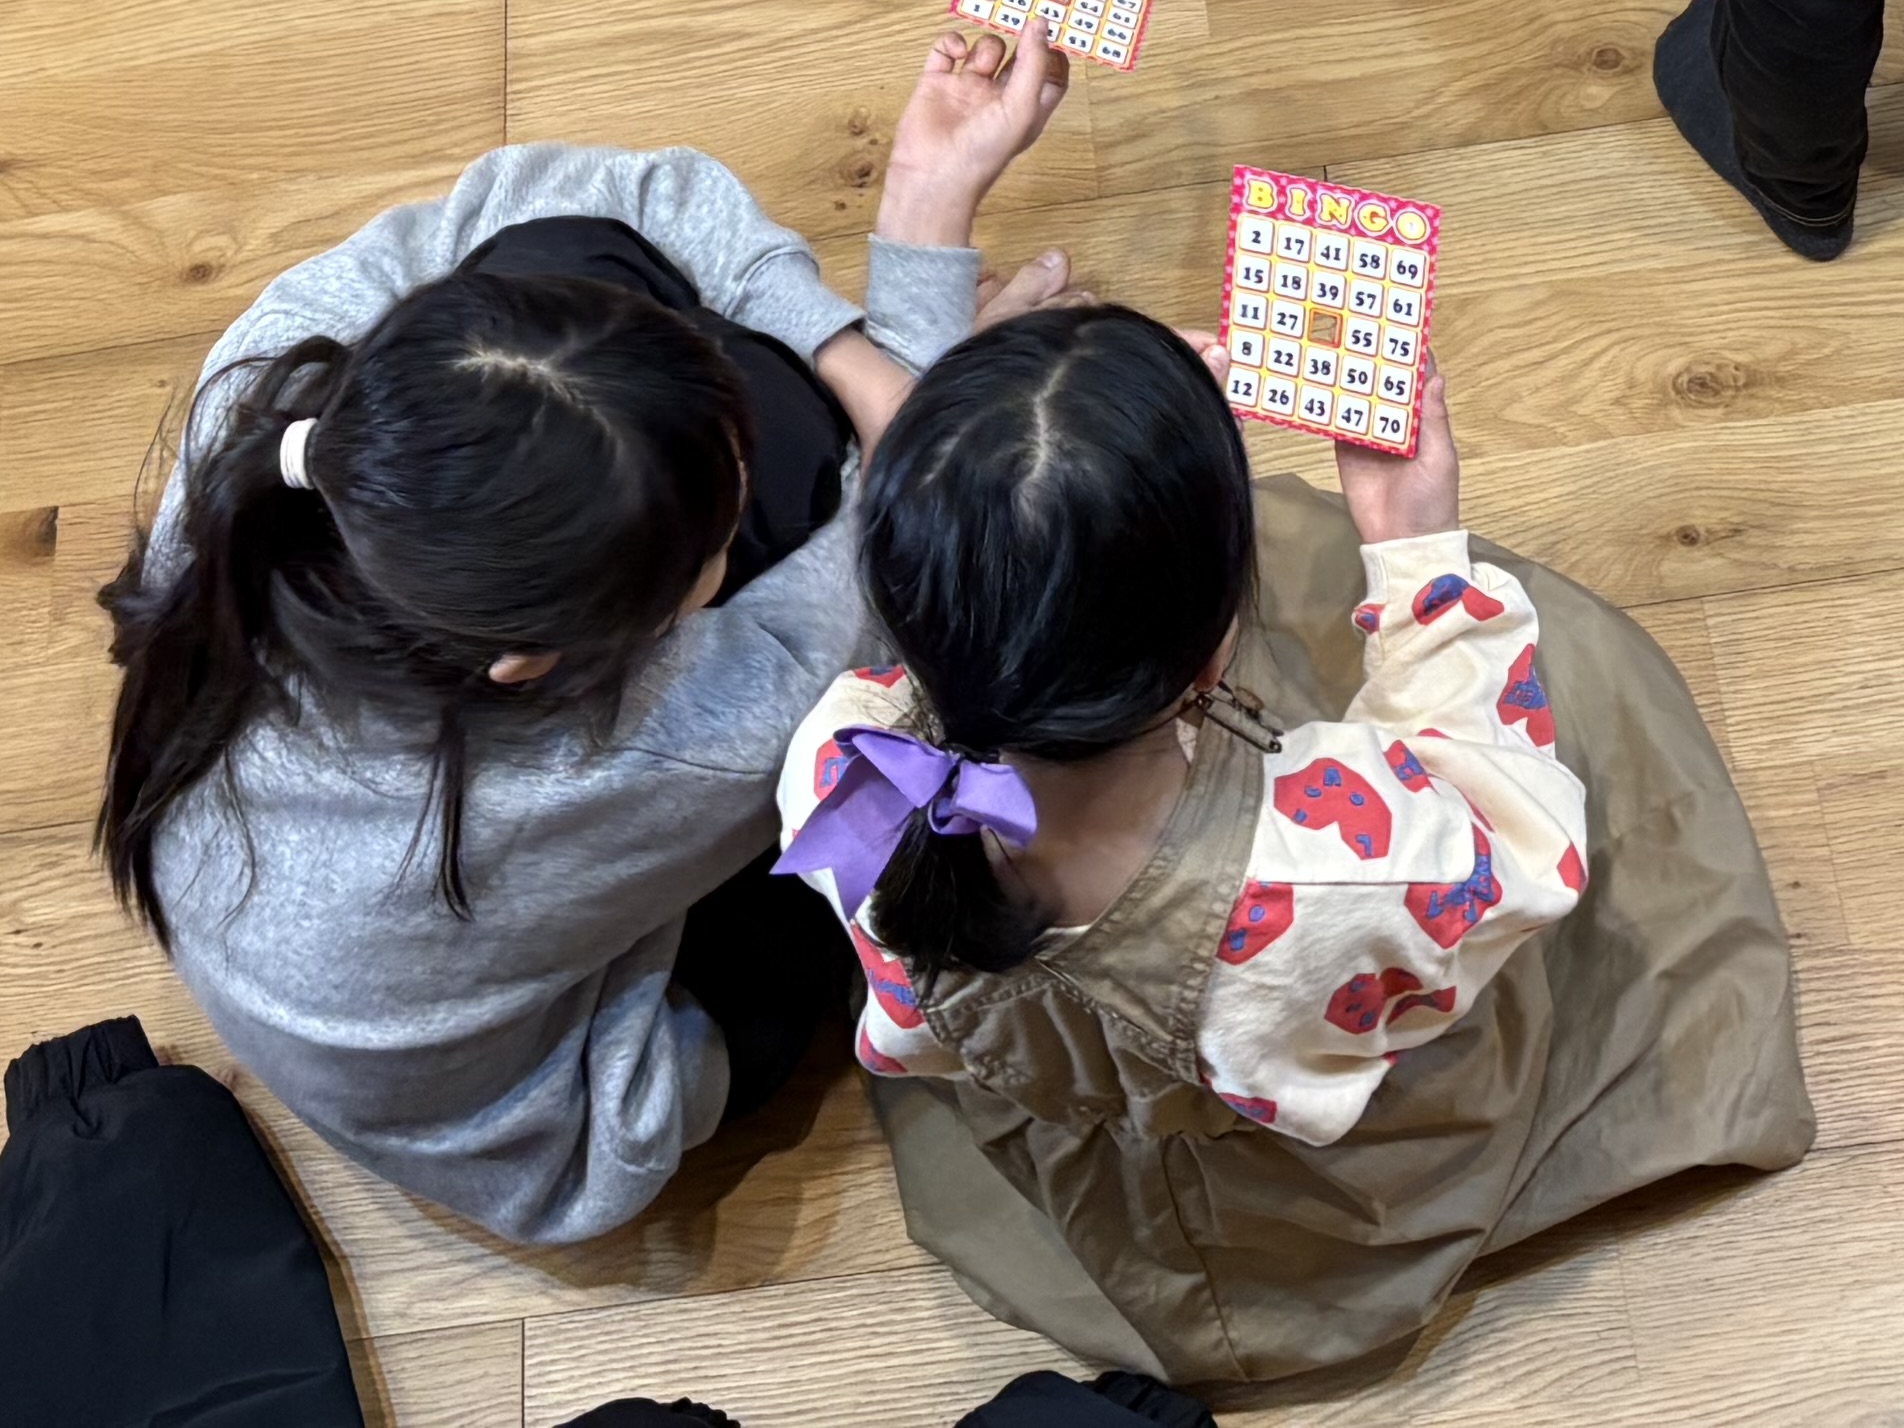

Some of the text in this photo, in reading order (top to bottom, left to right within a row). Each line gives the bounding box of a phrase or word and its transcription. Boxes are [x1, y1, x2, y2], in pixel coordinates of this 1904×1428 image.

[1245, 178, 1427, 241] BINGO
[1252, 230, 1418, 280] 2 17 41 58 69
[1244, 267, 1413, 316] 15 18 39 57 61
[1240, 304, 1410, 356] 11 27 55 75
[1242, 341, 1405, 395] 8 22 38 50 65
[1231, 380, 1400, 434] 12 26 43 47 70
